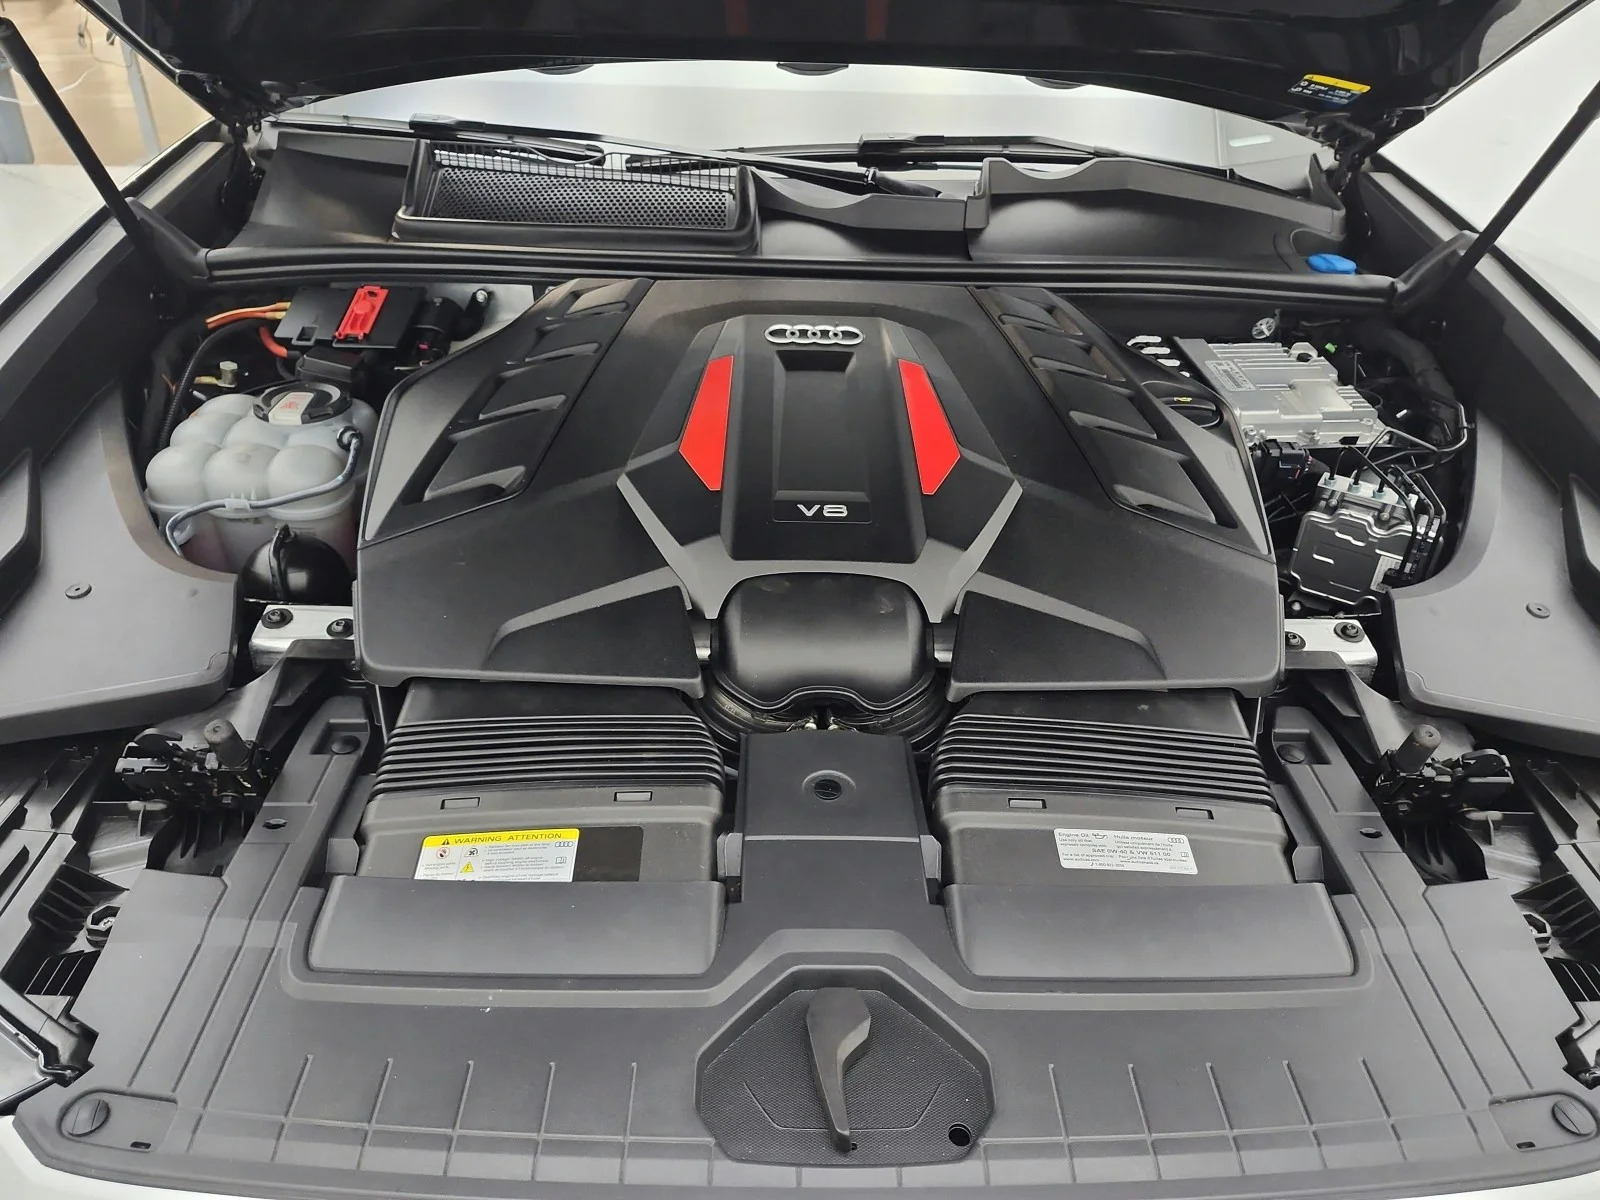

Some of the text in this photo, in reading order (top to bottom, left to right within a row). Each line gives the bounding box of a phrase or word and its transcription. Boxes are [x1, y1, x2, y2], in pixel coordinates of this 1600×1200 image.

[797, 504, 848, 517] V8
[454, 833, 562, 844] WARNING ATTENTION
